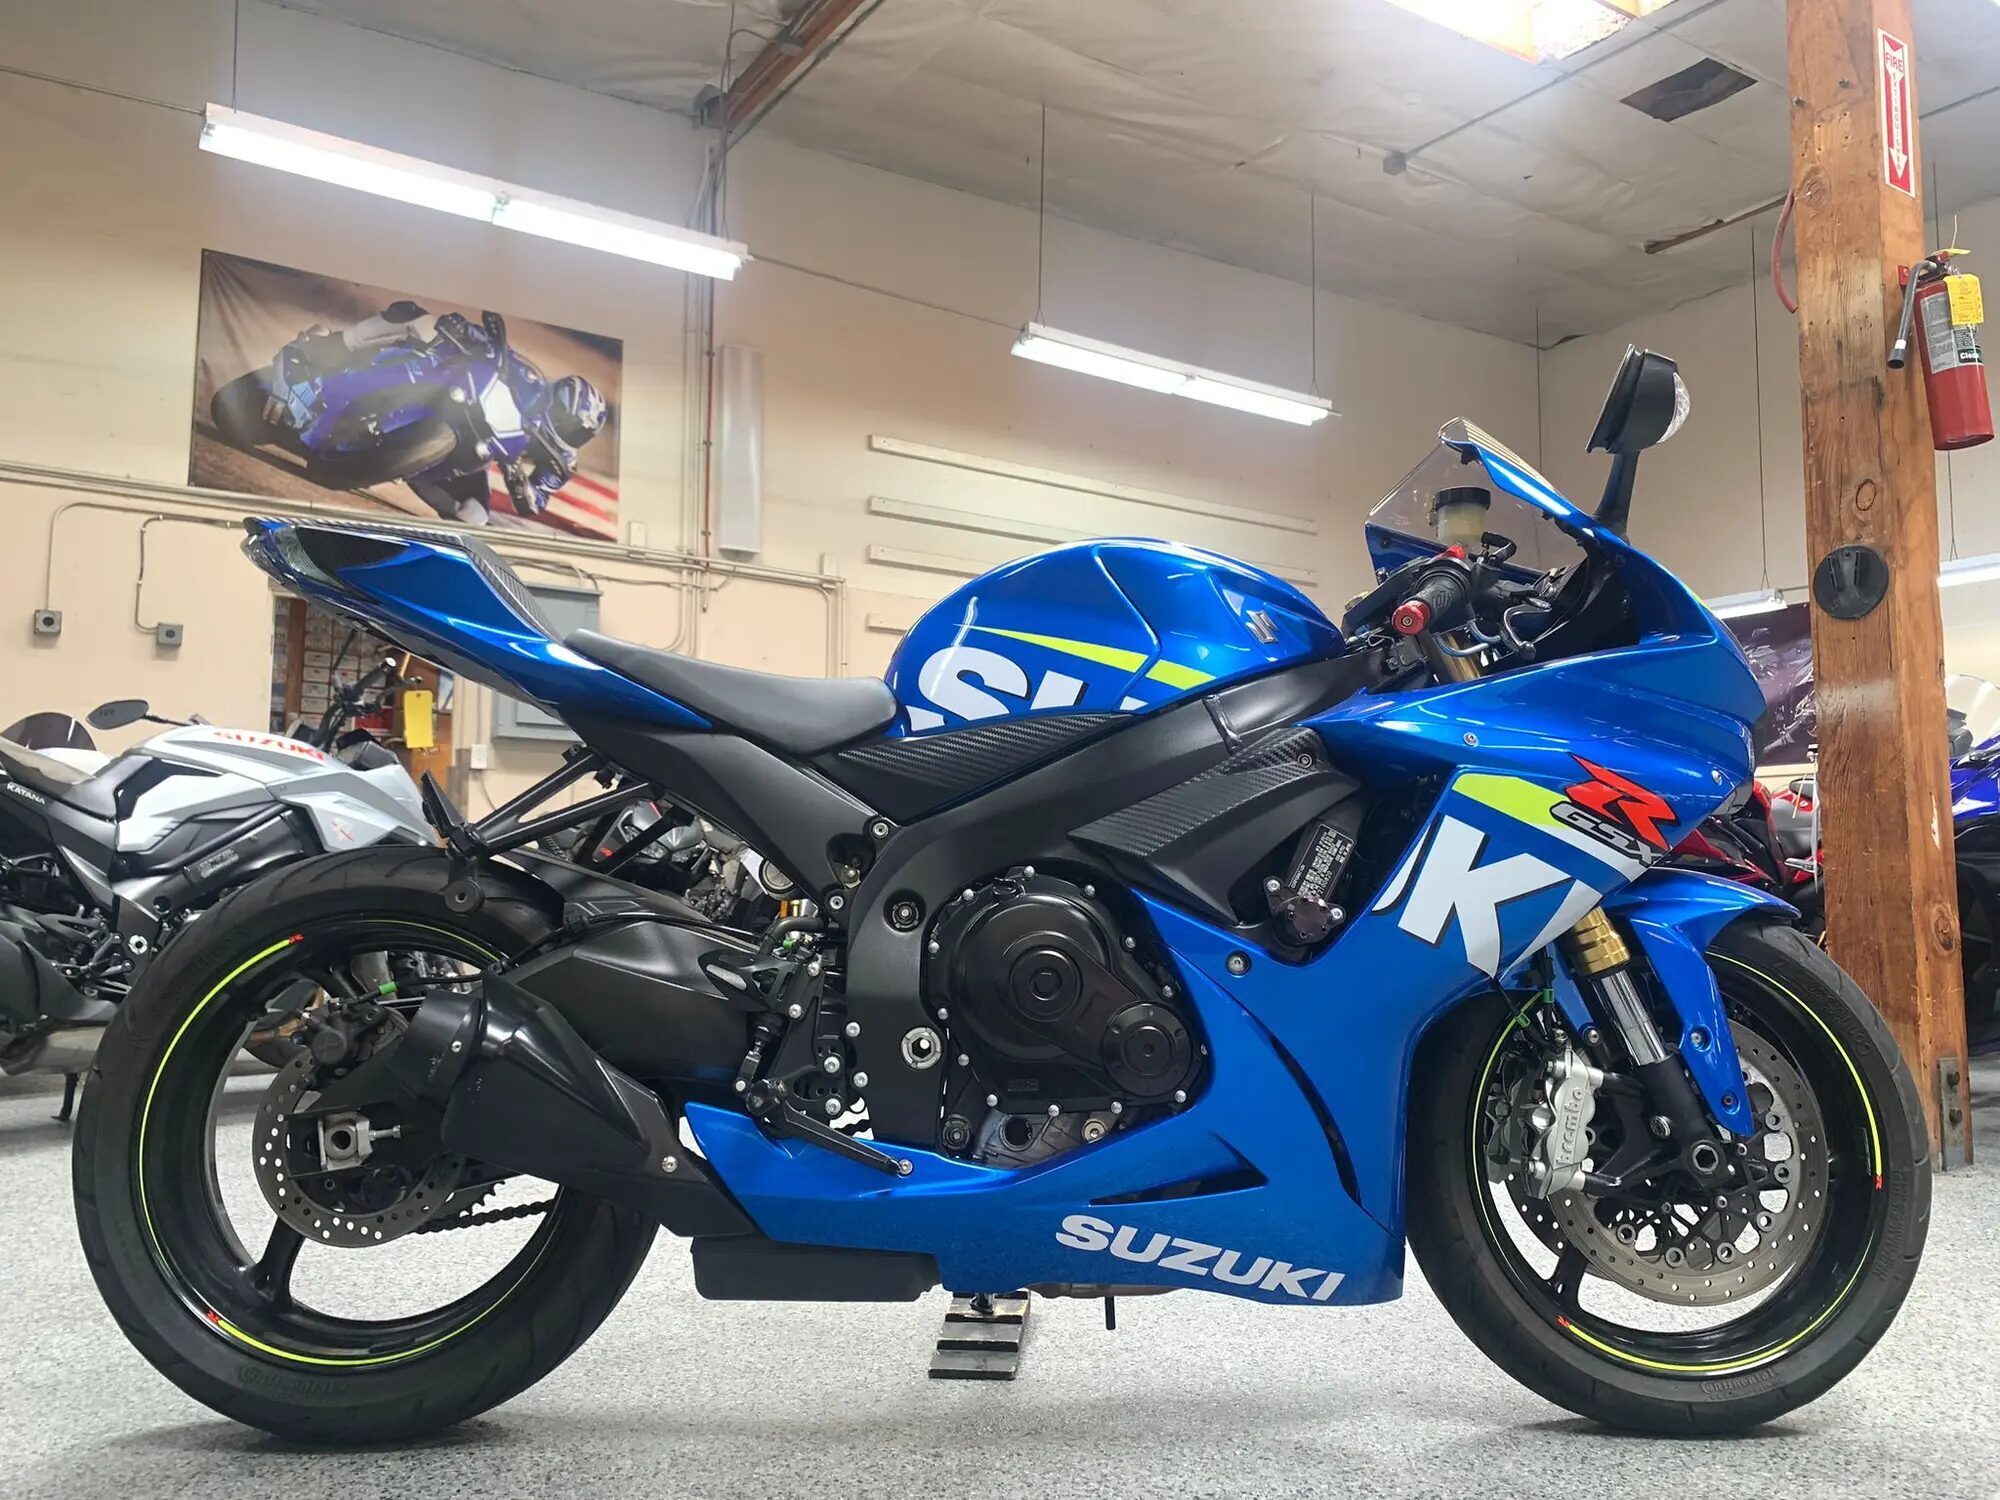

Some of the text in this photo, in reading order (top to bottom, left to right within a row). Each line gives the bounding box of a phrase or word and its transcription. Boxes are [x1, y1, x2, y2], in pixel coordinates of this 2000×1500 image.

[1885, 52, 1903, 73] FIRE
[6, 782, 46, 805] KATANA
[1555, 1086, 1586, 1165] brembo
[1055, 1214, 1345, 1301] SUZUKI
